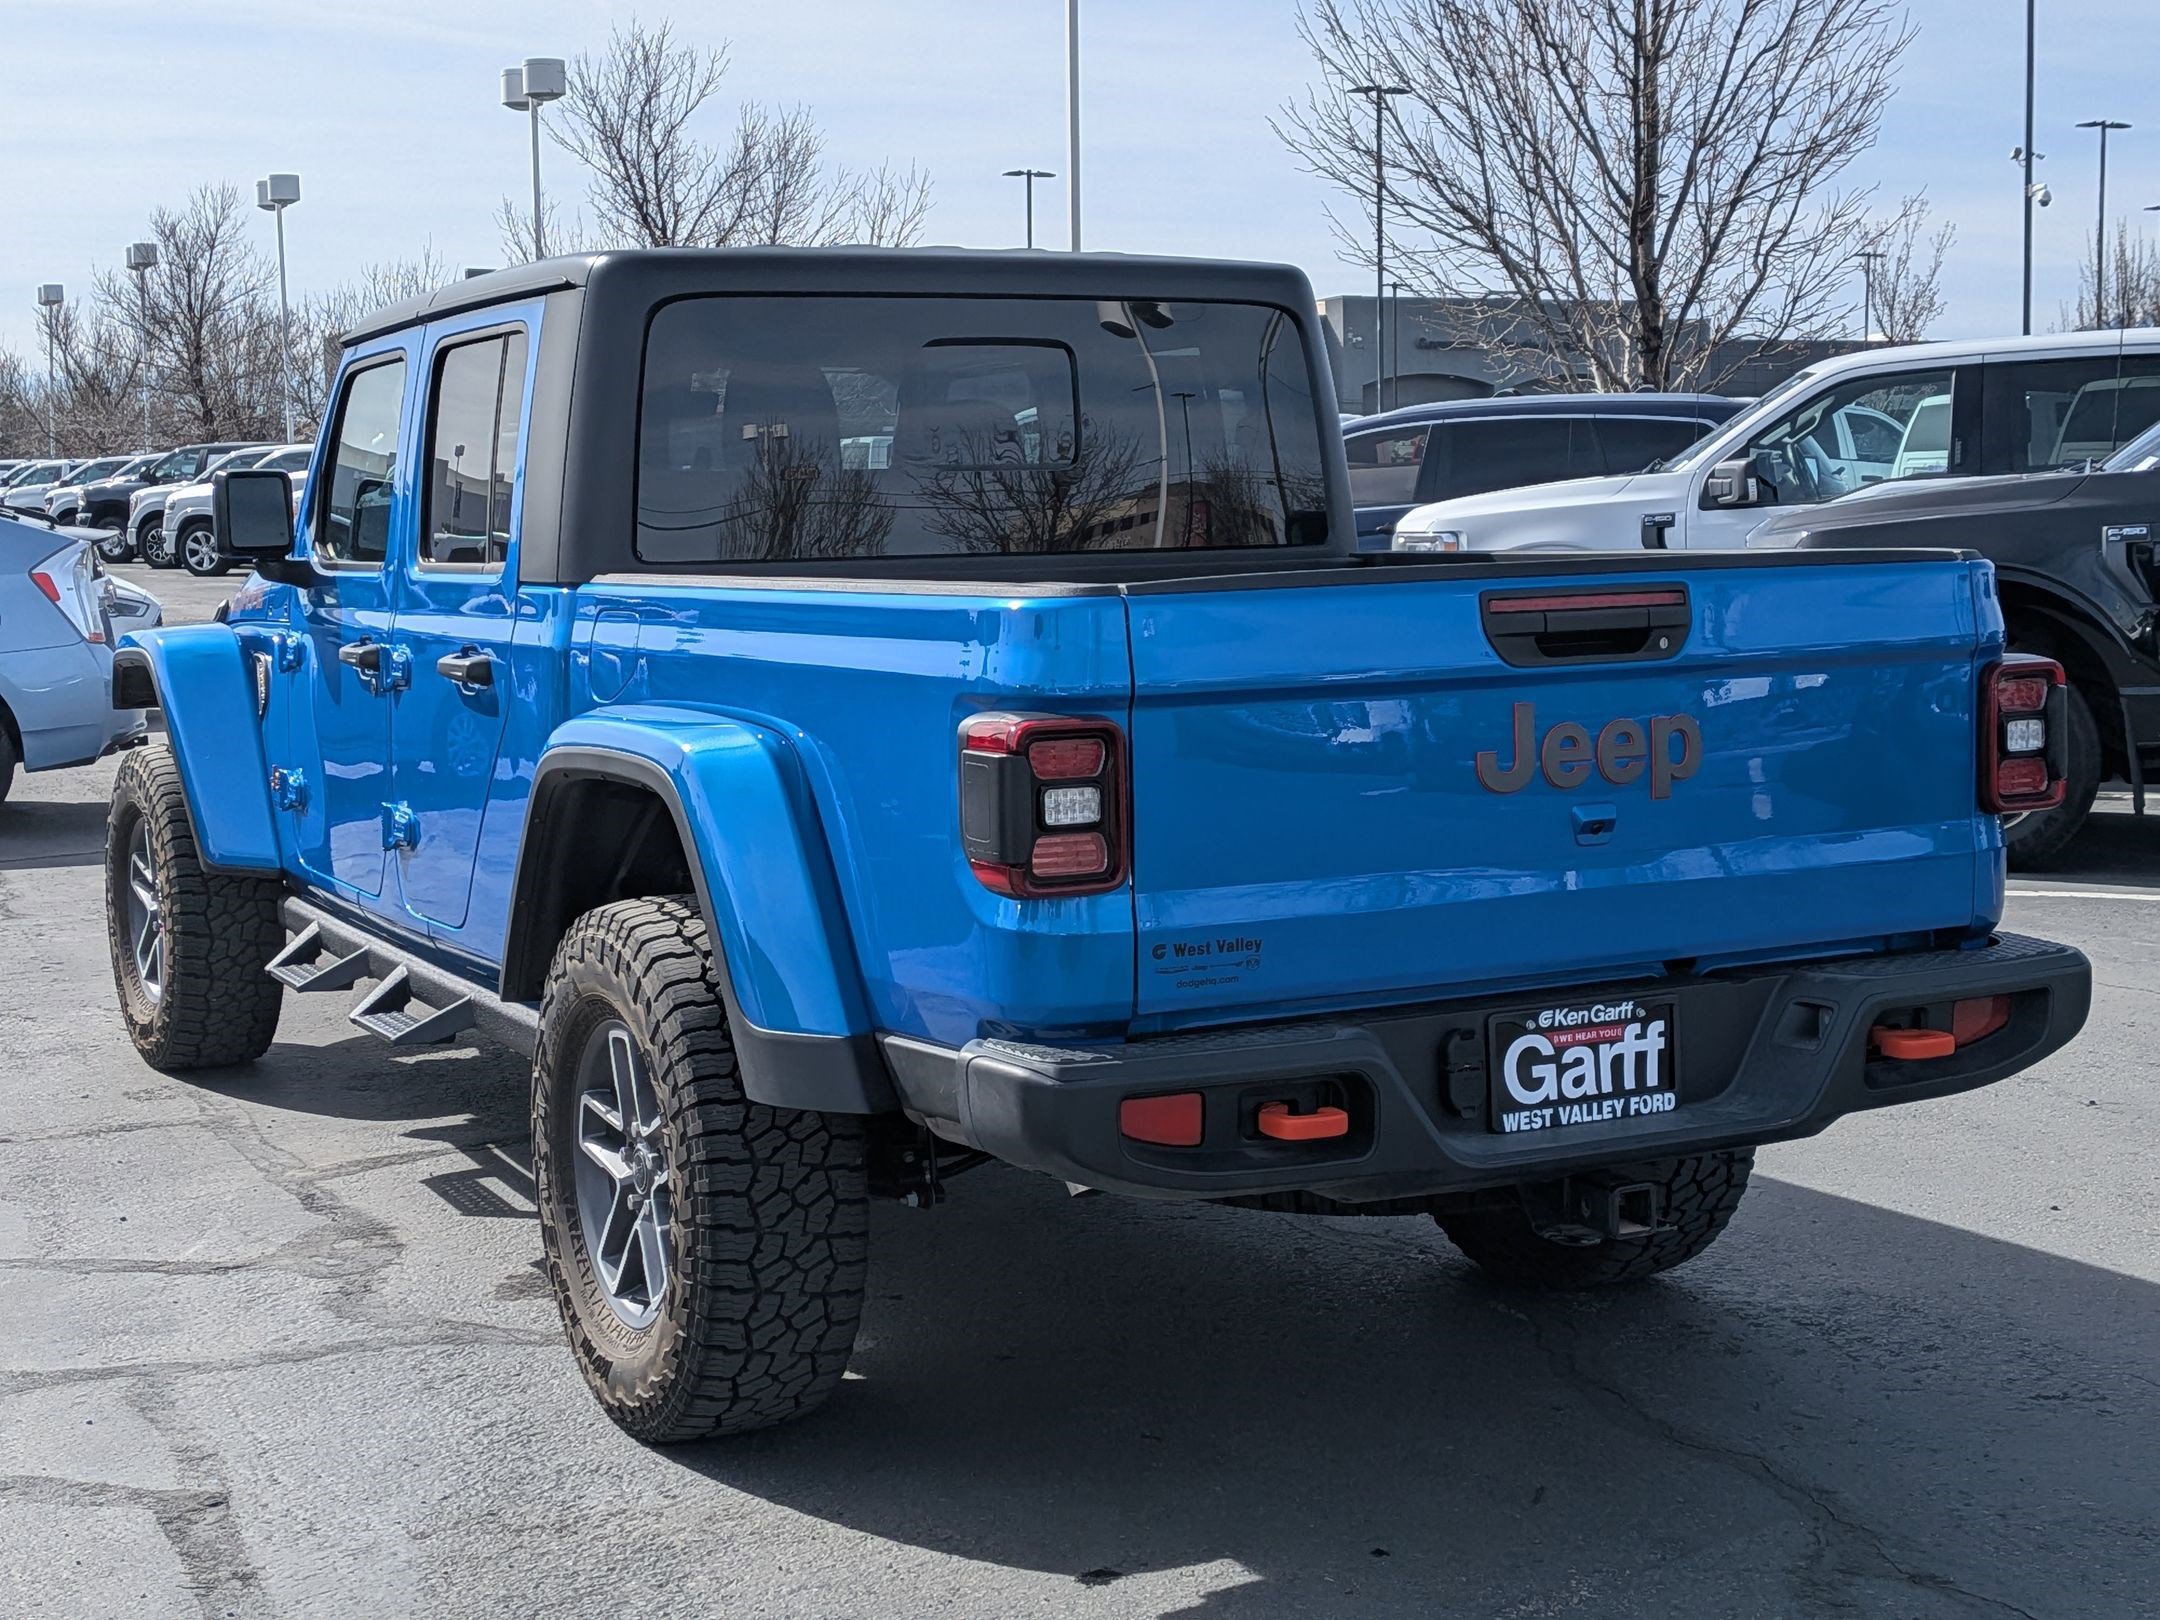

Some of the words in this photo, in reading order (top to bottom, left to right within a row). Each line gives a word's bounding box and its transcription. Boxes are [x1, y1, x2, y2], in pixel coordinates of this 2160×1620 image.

[1476, 702, 1704, 800] Jeep
[1173, 942, 1211, 957] West
[1216, 937, 1263, 953] Valley
[1555, 1007, 1589, 1027] Ken
[1590, 1001, 1634, 1022] Garff
[1559, 1033, 1573, 1043] WE
[1575, 1031, 1598, 1041] HEAR
[1599, 1028, 1617, 1038] YOU
[1503, 1020, 1665, 1105] Garff
[1502, 1109, 1554, 1133] WEST
[1558, 1099, 1624, 1126] VALLEY
[1629, 1092, 1676, 1115] FORD
